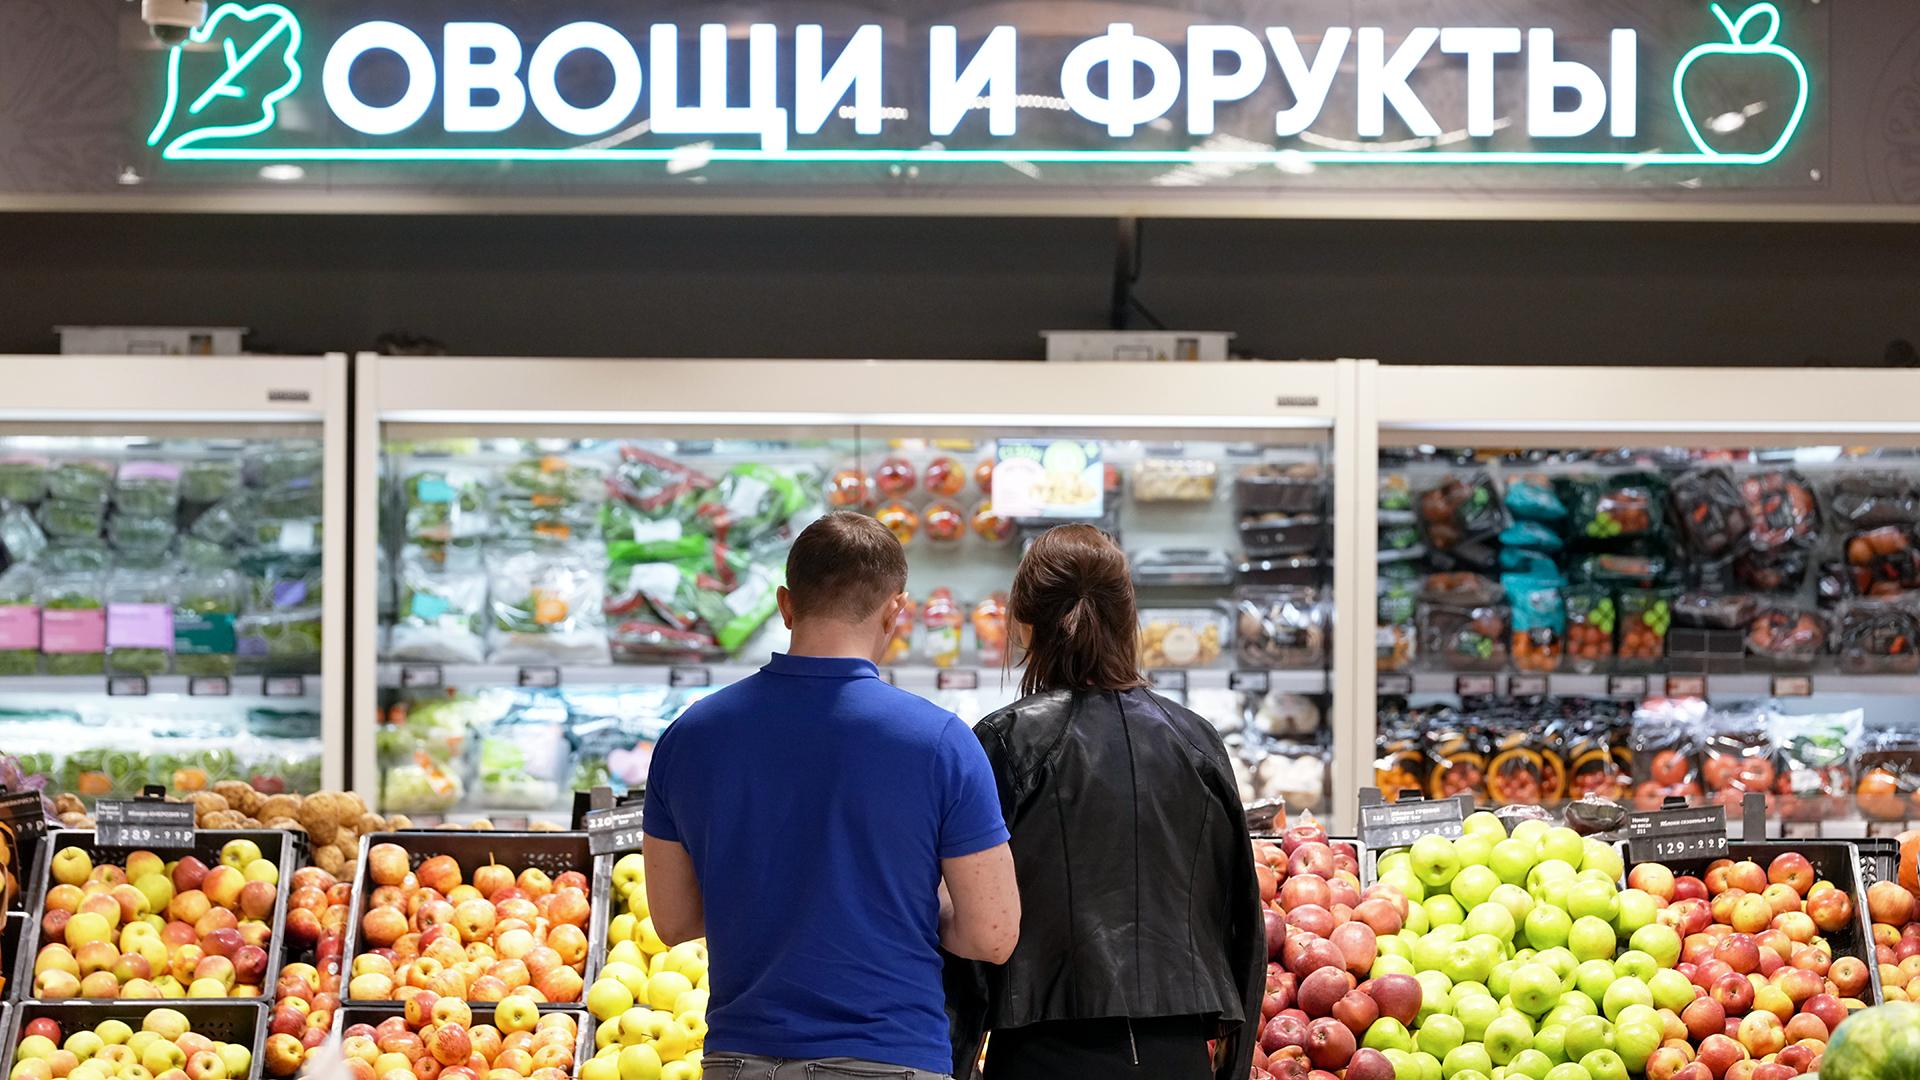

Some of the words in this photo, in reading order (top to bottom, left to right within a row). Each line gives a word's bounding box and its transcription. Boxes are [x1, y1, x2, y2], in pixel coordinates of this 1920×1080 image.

[323, 20, 884, 152] ОВОЩИ
[929, 25, 1017, 137] И
[1060, 22, 1638, 138] ФРУКТЫ
